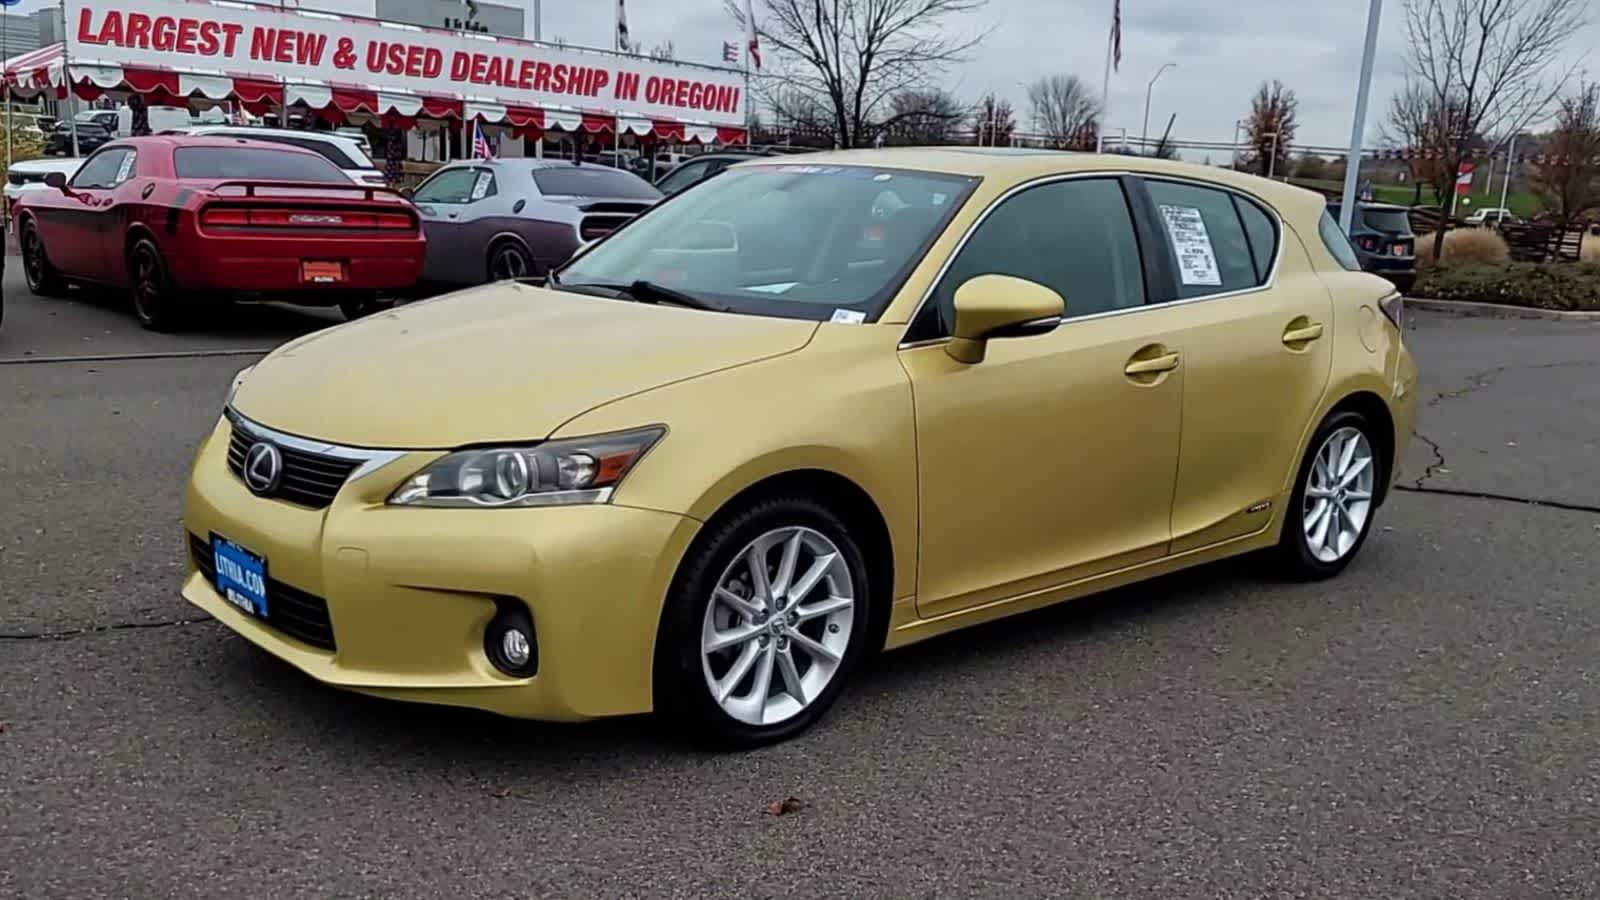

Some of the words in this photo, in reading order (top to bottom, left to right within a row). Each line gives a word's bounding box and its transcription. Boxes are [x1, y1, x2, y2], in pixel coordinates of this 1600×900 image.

[77, 8, 243, 58] LARGEST
[250, 27, 327, 66] NEW
[332, 37, 358, 70] &
[365, 41, 443, 78] USED
[450, 51, 609, 97] DEALERSHIP
[614, 71, 640, 102] IN
[645, 76, 741, 113] OREGON!
